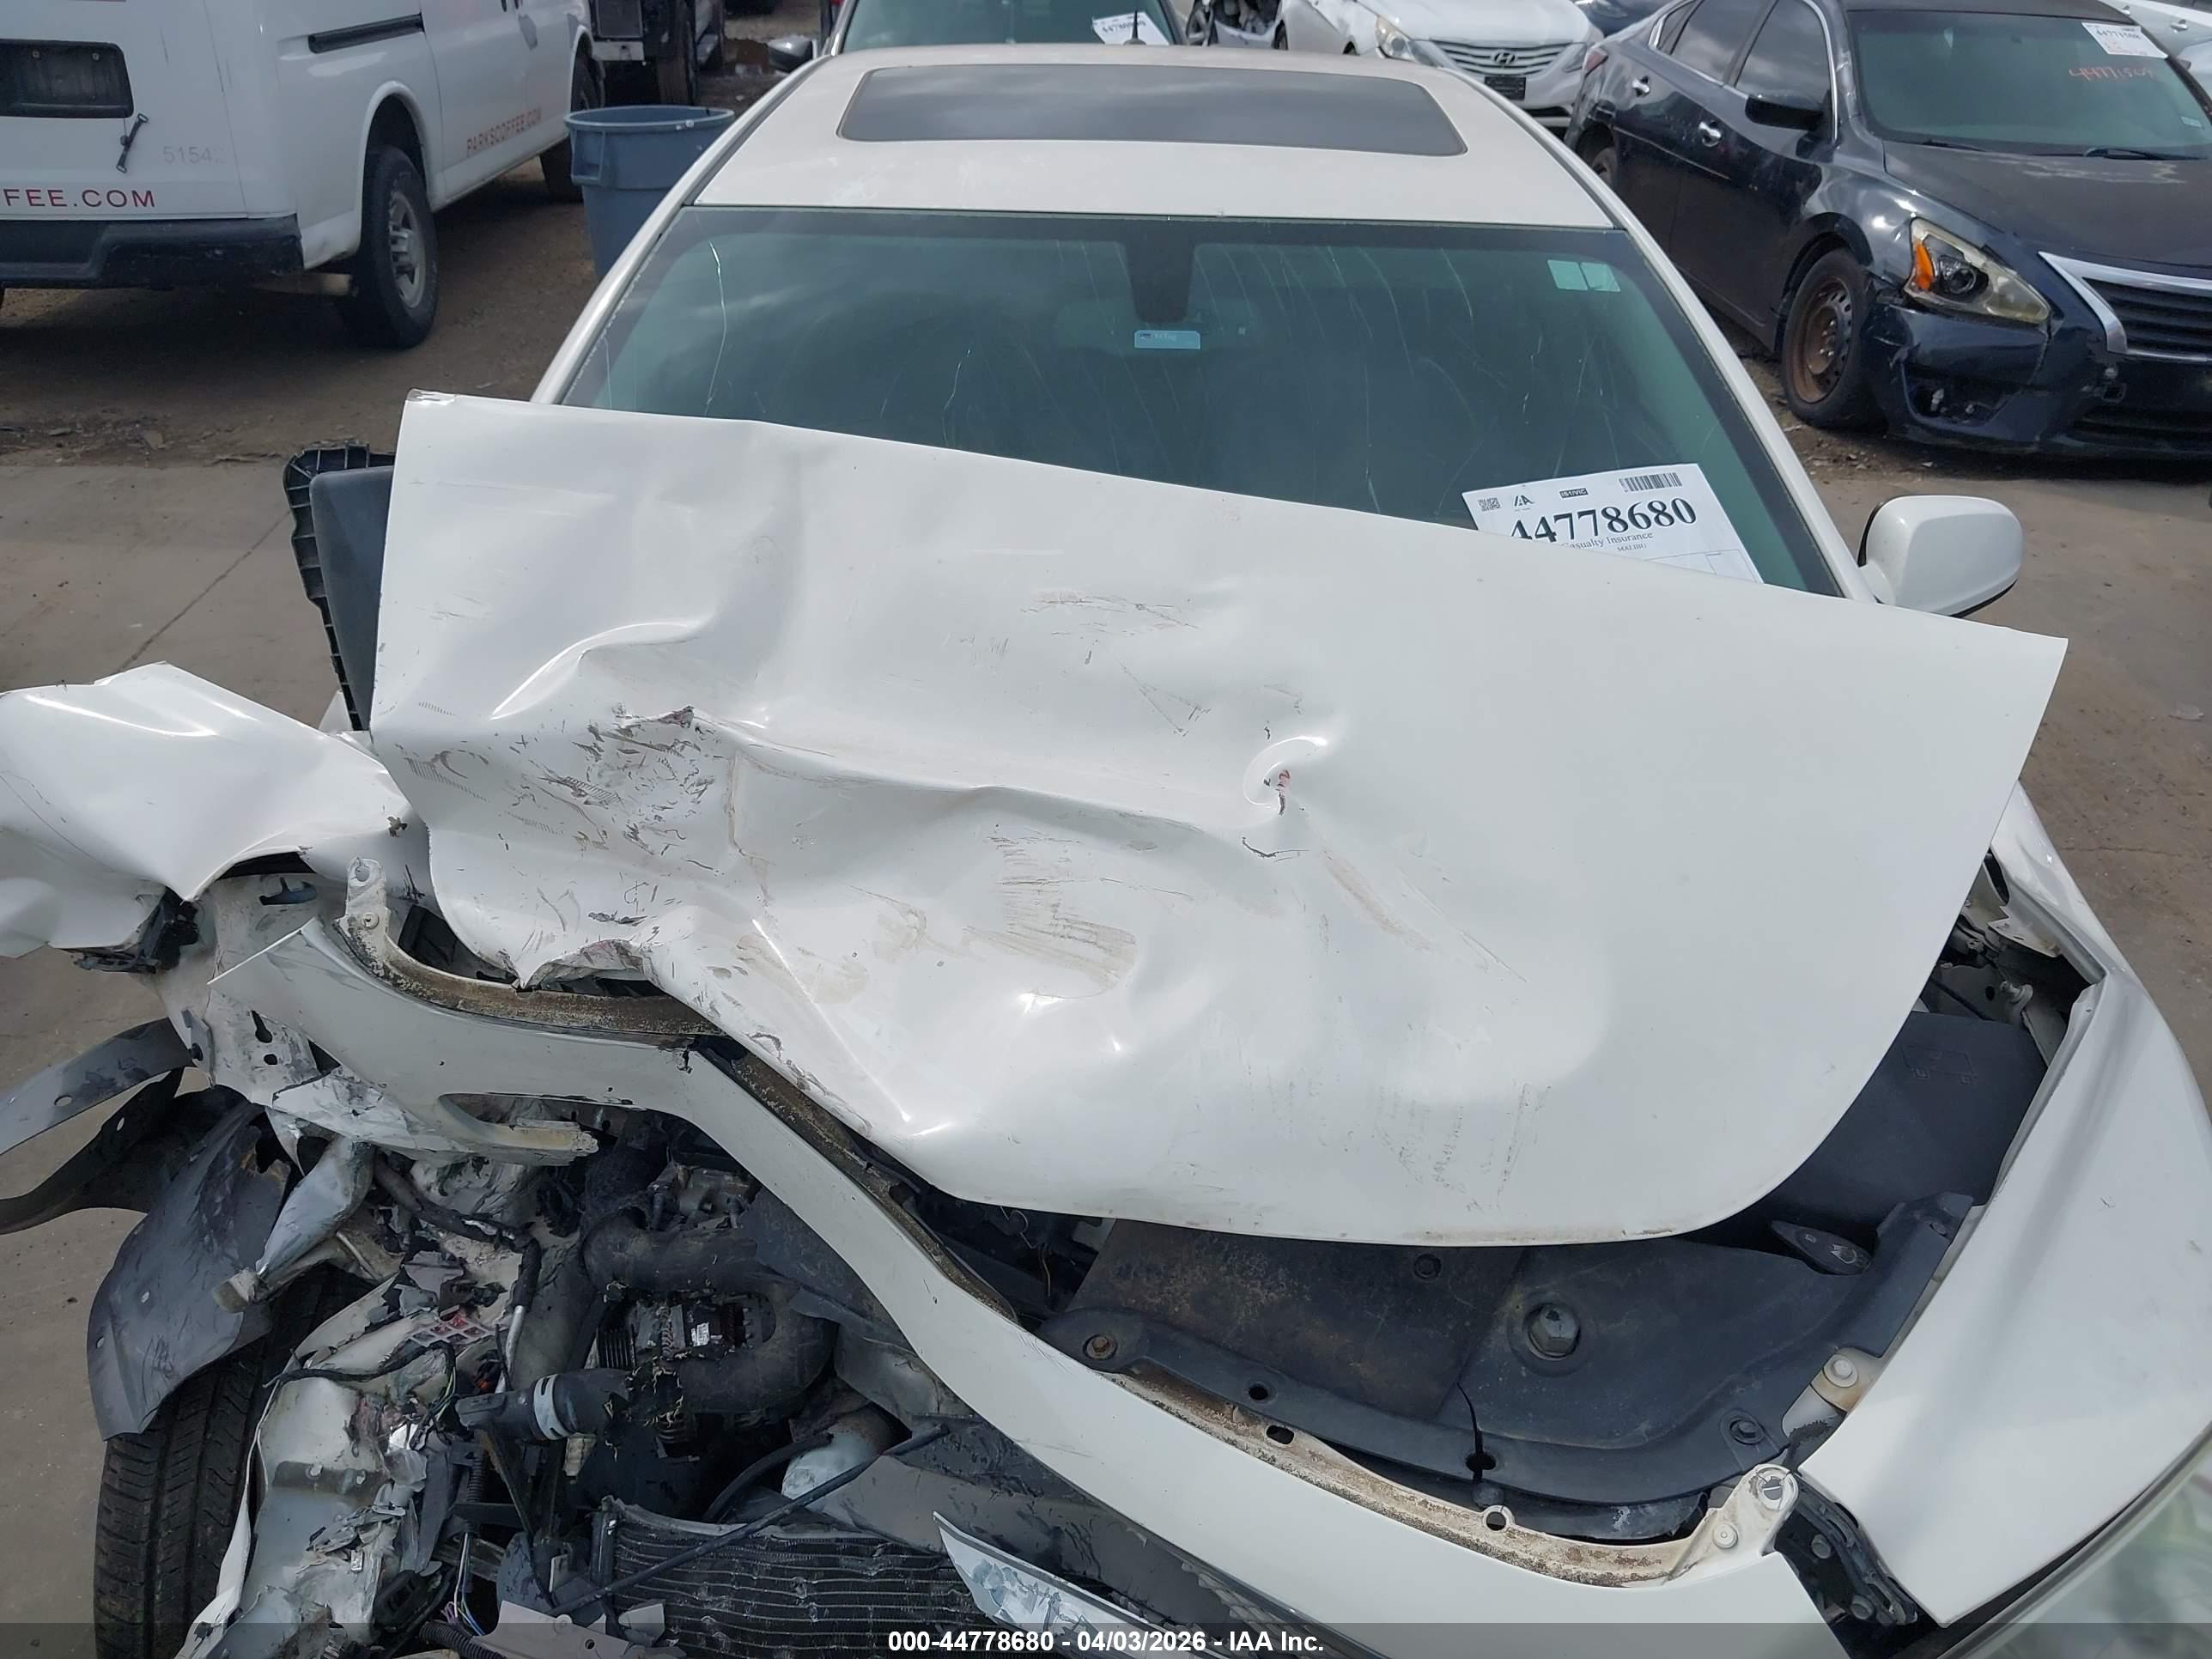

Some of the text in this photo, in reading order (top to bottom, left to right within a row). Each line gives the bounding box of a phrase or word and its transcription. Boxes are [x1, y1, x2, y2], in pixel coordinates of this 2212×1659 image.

[3, 188, 155, 208] FEE.COM
[1511, 497, 1697, 543] 44778680
[1607, 532, 1654, 544] Insurance
